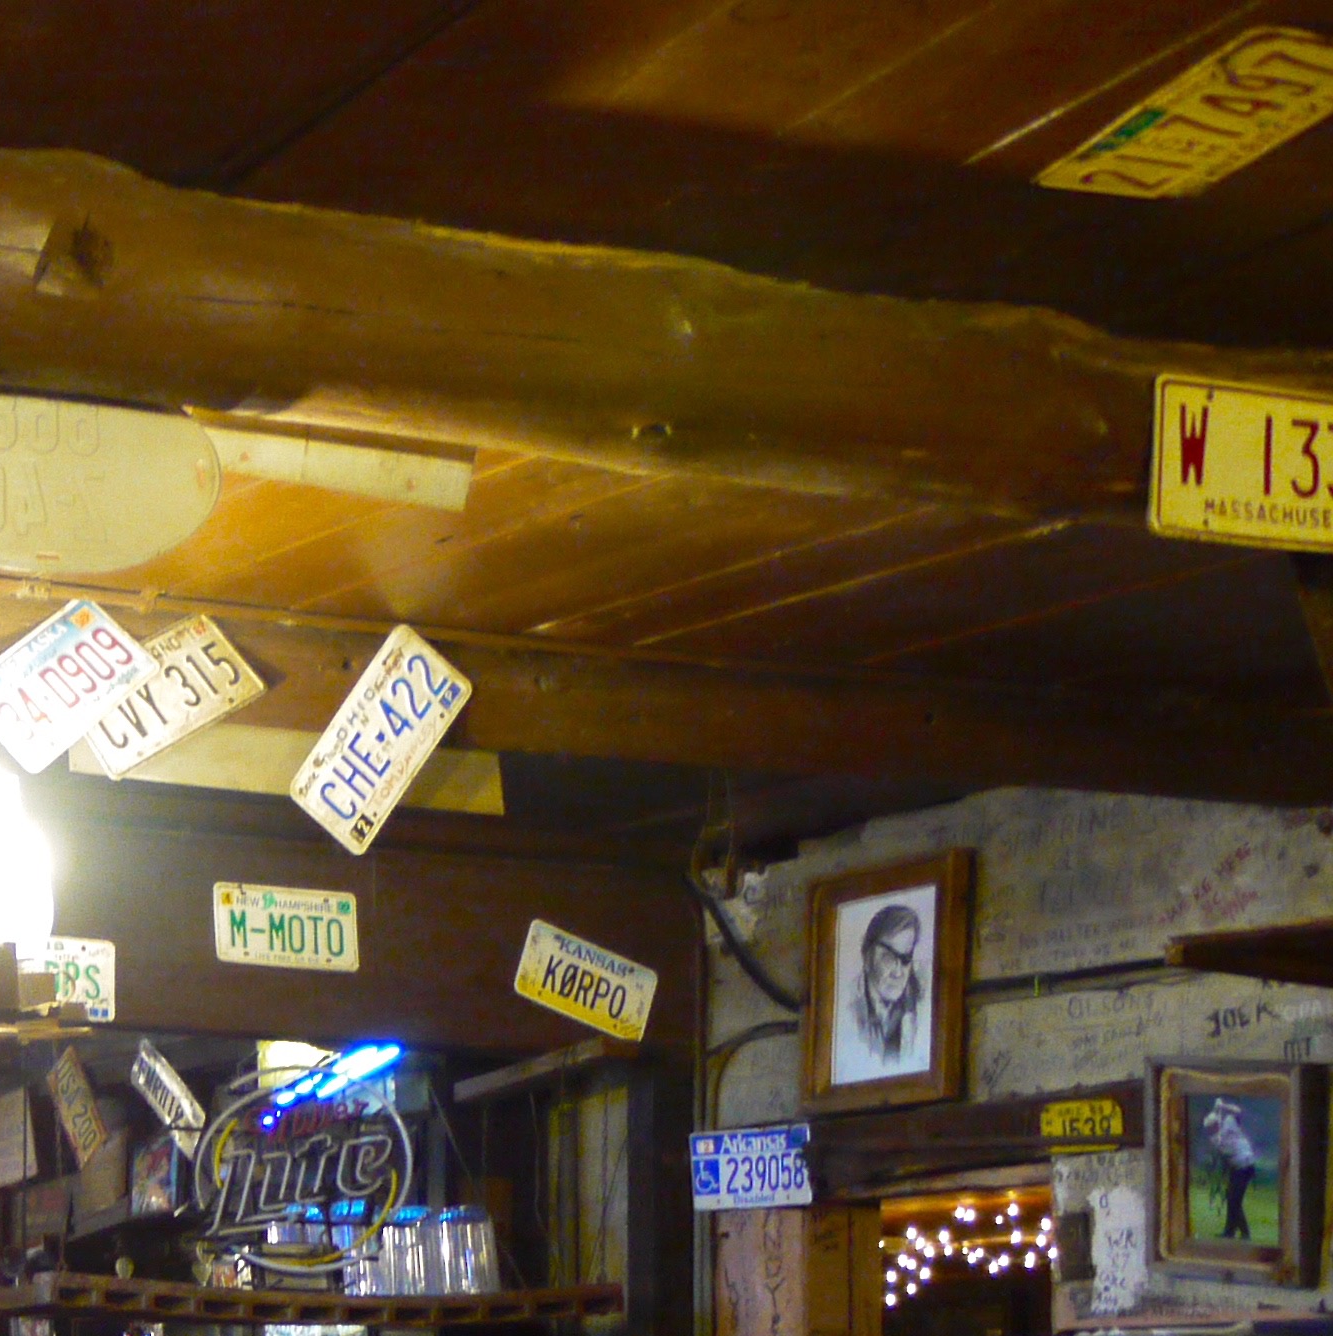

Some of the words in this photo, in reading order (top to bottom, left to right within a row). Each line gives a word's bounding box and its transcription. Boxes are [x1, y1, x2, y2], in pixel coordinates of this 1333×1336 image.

[1178, 402, 1211, 488] W
[1263, 413, 1333, 502] 13
[98, 682, 169, 750] CVY
[164, 641, 240, 708] 315
[235, 895, 261, 909] NEW
[273, 900, 334, 914] HAMPSHIRE
[228, 908, 347, 959] M-MOTO
[557, 936, 631, 978] KANSAS
[719, 1131, 788, 1155] Arkansas
[725, 1154, 806, 1196] 239058
